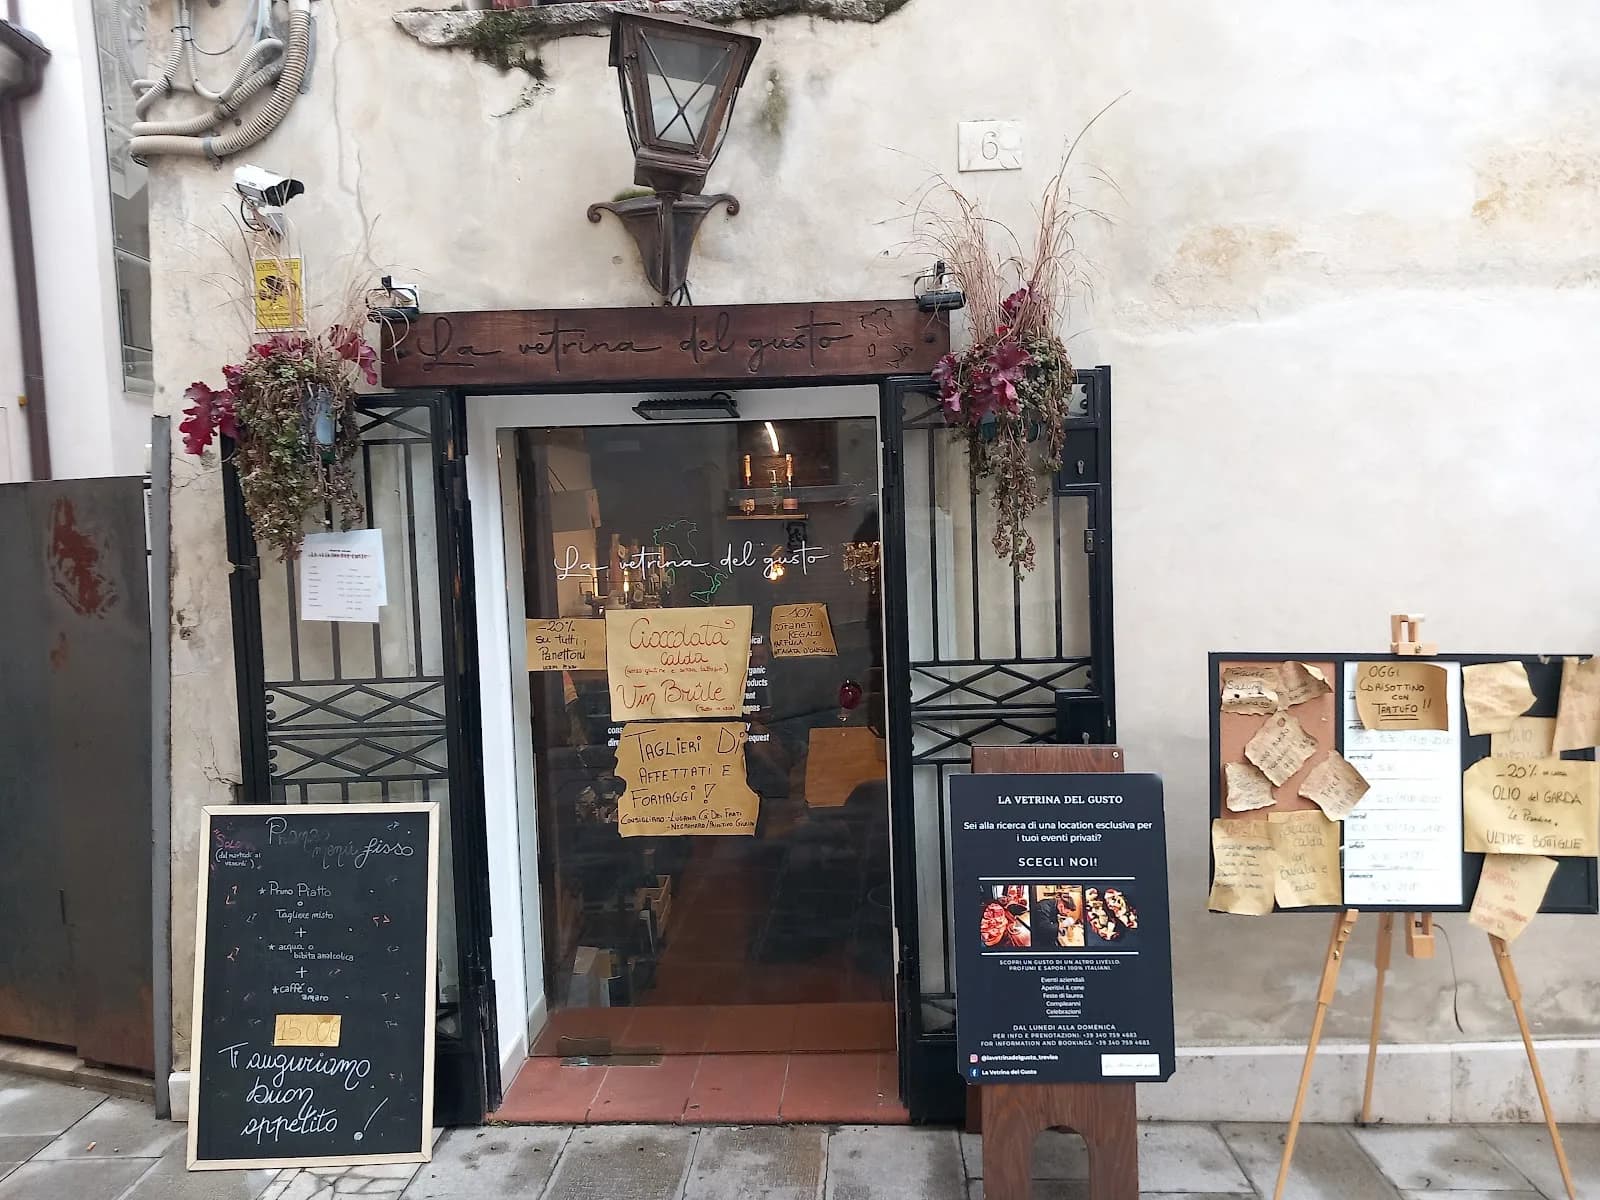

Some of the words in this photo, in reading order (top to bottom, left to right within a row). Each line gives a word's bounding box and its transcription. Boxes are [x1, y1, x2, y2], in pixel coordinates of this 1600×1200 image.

[417, 316, 501, 371] La
[518, 318, 663, 374] vetrina
[679, 316, 740, 364] del
[747, 310, 853, 372] gusto
[554, 546, 608, 580] La
[618, 546, 709, 579] vetrina
[719, 540, 755, 573] del
[763, 540, 832, 579] gusto
[535, 635, 551, 644] su
[629, 617, 735, 649] Cioccolata
[1369, 665, 1400, 678] OGGI
[722, 764, 732, 776] E
[998, 795, 1012, 804] LA
[1014, 795, 1061, 804] VETRINA
[1064, 795, 1085, 804] DEL
[1088, 795, 1123, 804] GUSTO
[1492, 785, 1521, 801] OLIO
[1544, 790, 1583, 805] GARDA
[963, 821, 977, 830] Sei
[979, 821, 994, 830] alla
[996, 821, 1026, 830] ricerca
[1028, 821, 1037, 830] di
[1039, 822, 1056, 830] una
[1057, 821, 1094, 830] location
[1095, 821, 1135, 830] esclusiva
[1137, 823, 1152, 831] per
[1016, 834, 1020, 842] i
[1022, 834, 1039, 842] tuoi
[1041, 834, 1068, 842] eventi
[1070, 834, 1102, 843] privati?
[1486, 829, 1524, 845] ULTIME
[354, 838, 414, 868] fisso
[1018, 857, 1064, 867] SCEGLI
[1069, 857, 1098, 867] NOI!
[293, 951, 315, 960] bibita
[246, 1052, 371, 1091] auguriamo
[246, 1077, 314, 1117] buon
